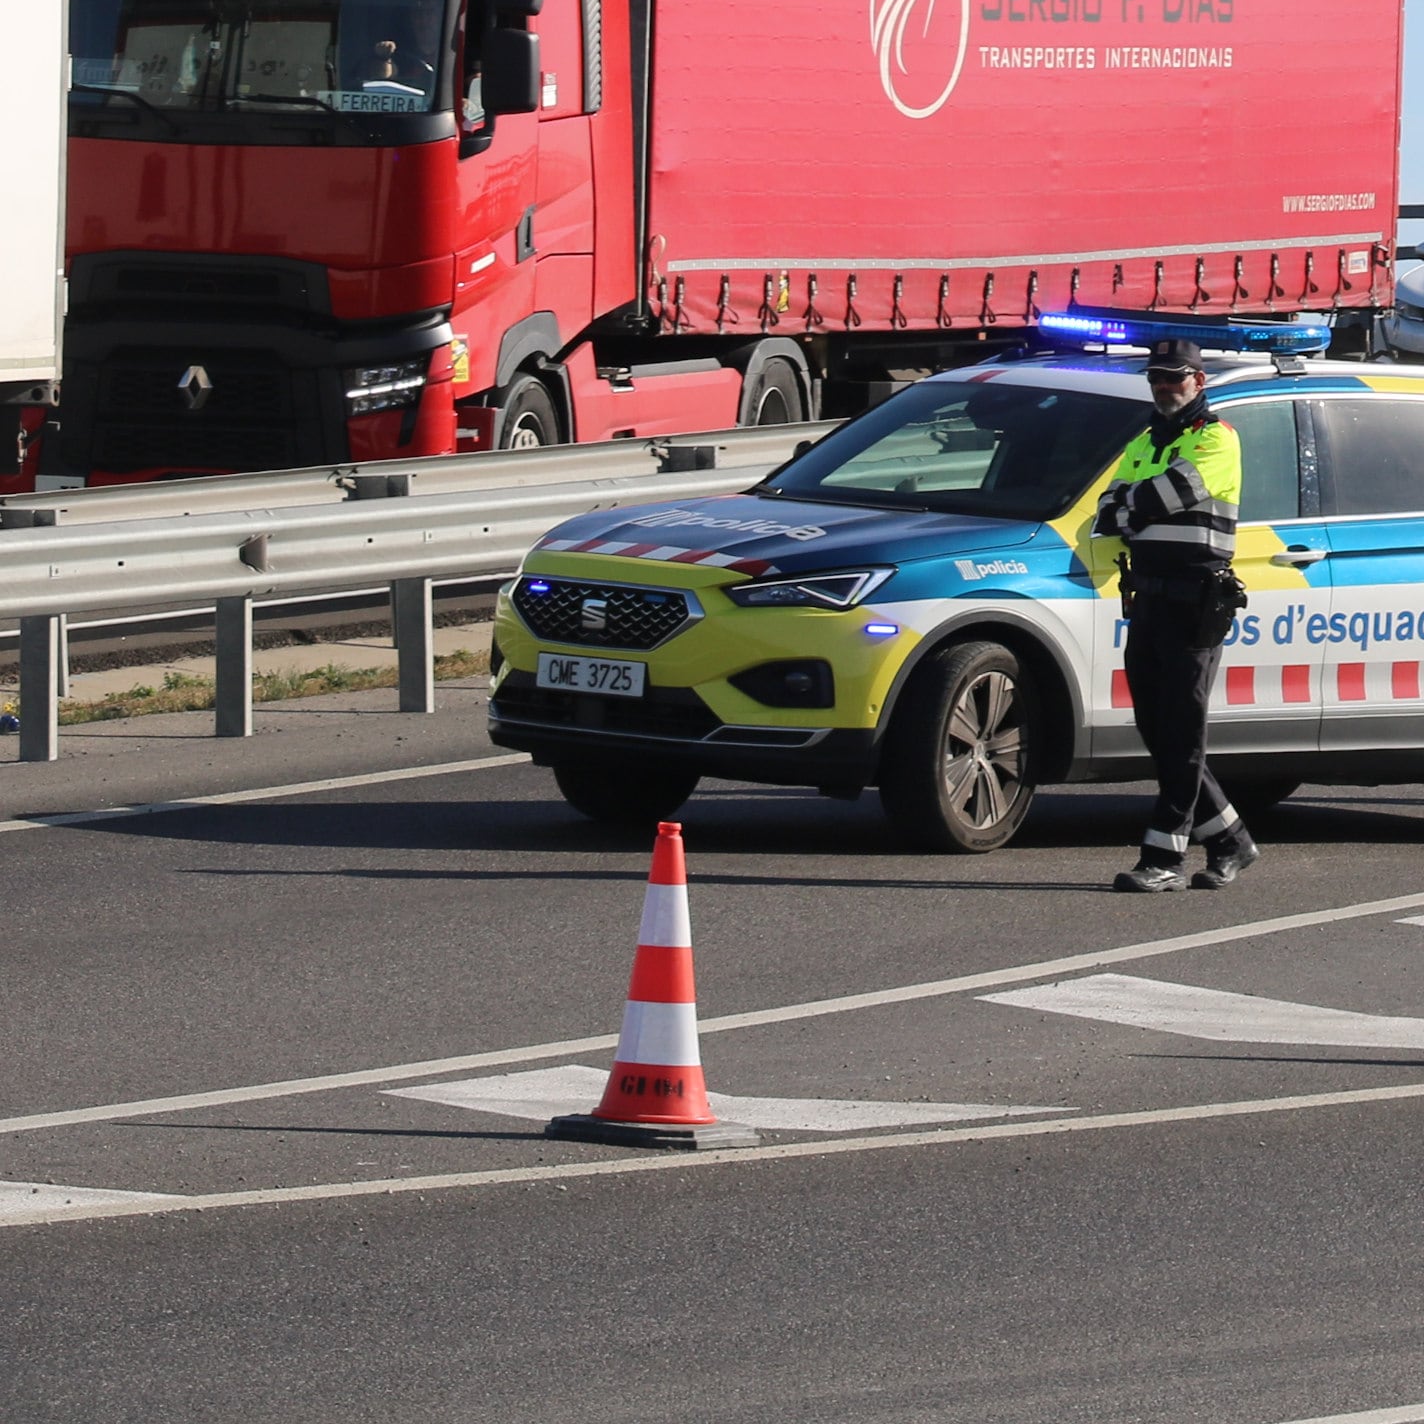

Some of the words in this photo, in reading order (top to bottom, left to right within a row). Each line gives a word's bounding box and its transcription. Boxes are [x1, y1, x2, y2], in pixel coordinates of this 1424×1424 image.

[979, 46, 1096, 69] TRANSPORTES
[1104, 47, 1233, 68] INTERNACIONAIS
[976, 559, 1029, 578] policia
[548, 659, 580, 686] CME
[587, 663, 633, 691] 3725
